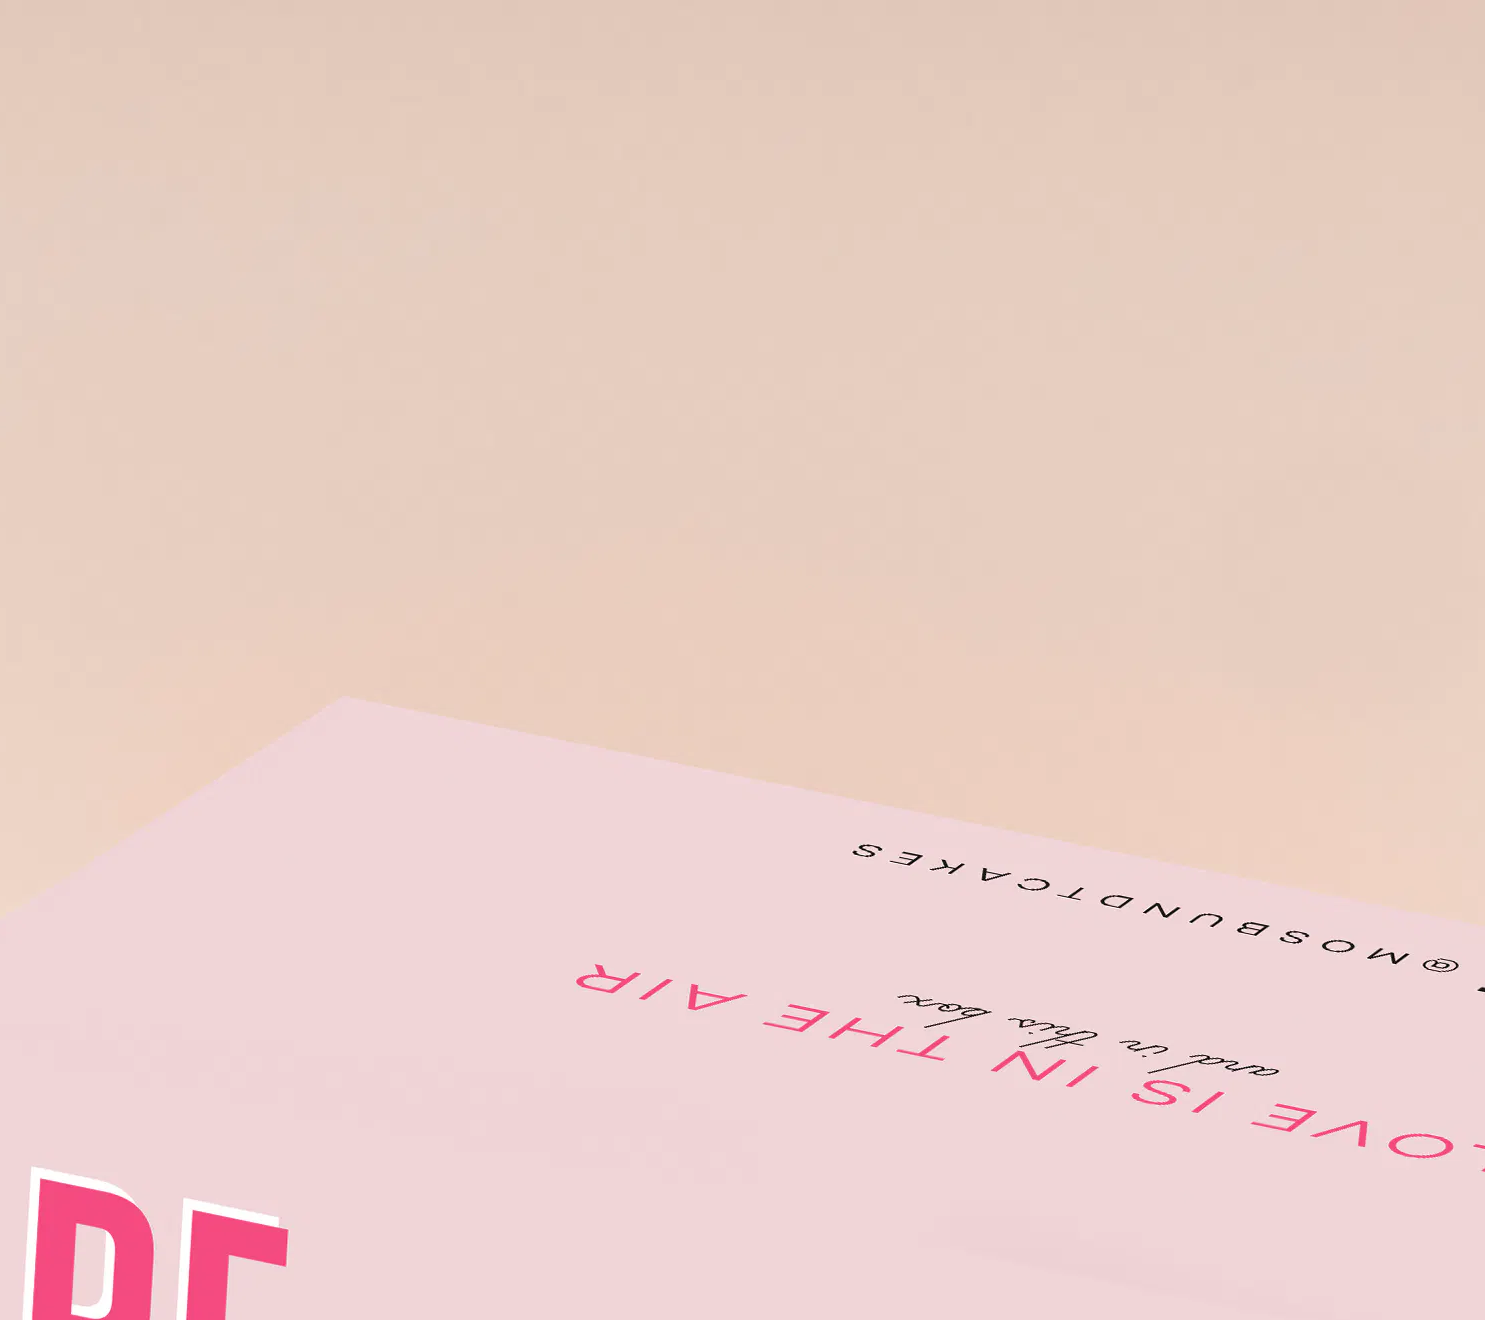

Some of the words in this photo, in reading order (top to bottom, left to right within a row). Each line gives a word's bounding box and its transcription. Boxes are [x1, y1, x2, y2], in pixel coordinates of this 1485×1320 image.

[851, 842, 1460, 973] @MOSBUNDTCAKES
[575, 963, 749, 1012] AIR
[896, 993, 993, 1029] box
[761, 1003, 951, 1062] THE
[1006, 1016, 1098, 1050] this
[1118, 1039, 1169, 1058] in
[989, 1050, 1100, 1088] IN
[1146, 1053, 1280, 1076] and
[1130, 1078, 1226, 1114] IS
